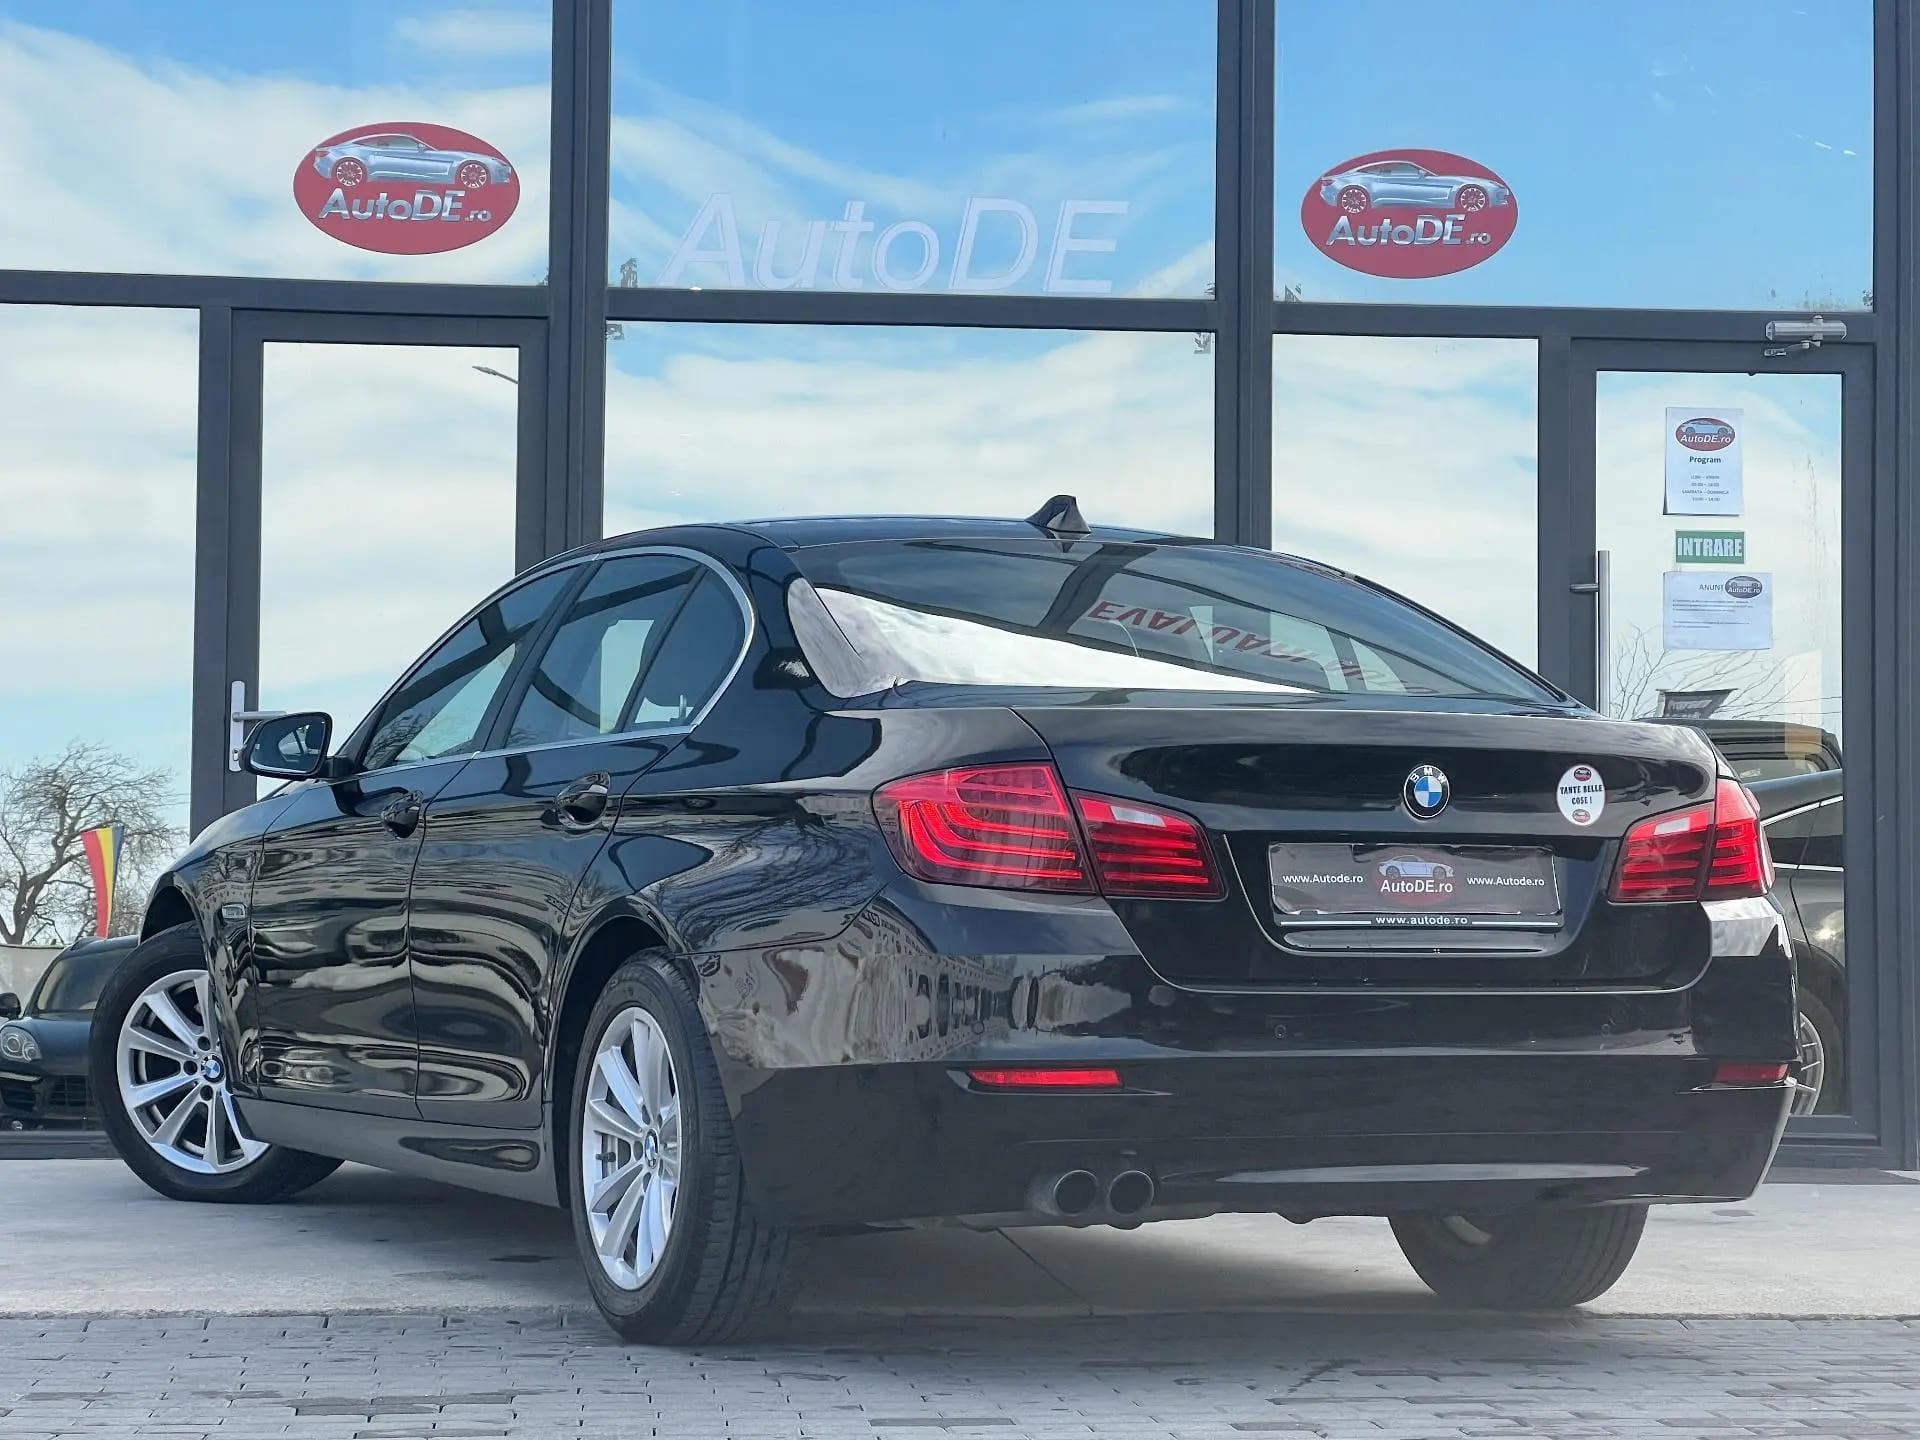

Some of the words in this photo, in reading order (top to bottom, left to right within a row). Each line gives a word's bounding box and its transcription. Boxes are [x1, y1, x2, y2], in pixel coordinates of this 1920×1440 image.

[656, 192, 1129, 293] AutoDE
[1689, 456, 1721, 464] Program
[1677, 538, 1743, 557] INTRARE
[1410, 767, 1447, 783] BMW
[1560, 786, 1581, 795] TANTE
[1583, 784, 1603, 793] BELLE
[1571, 796, 1588, 805] COSE
[1282, 873, 1364, 884] www.Autode.ro
[1466, 876, 1545, 887] www.Autode.ro
[1380, 879, 1454, 893] AutoDE.ro
[1375, 915, 1468, 925] www.autode.ro
